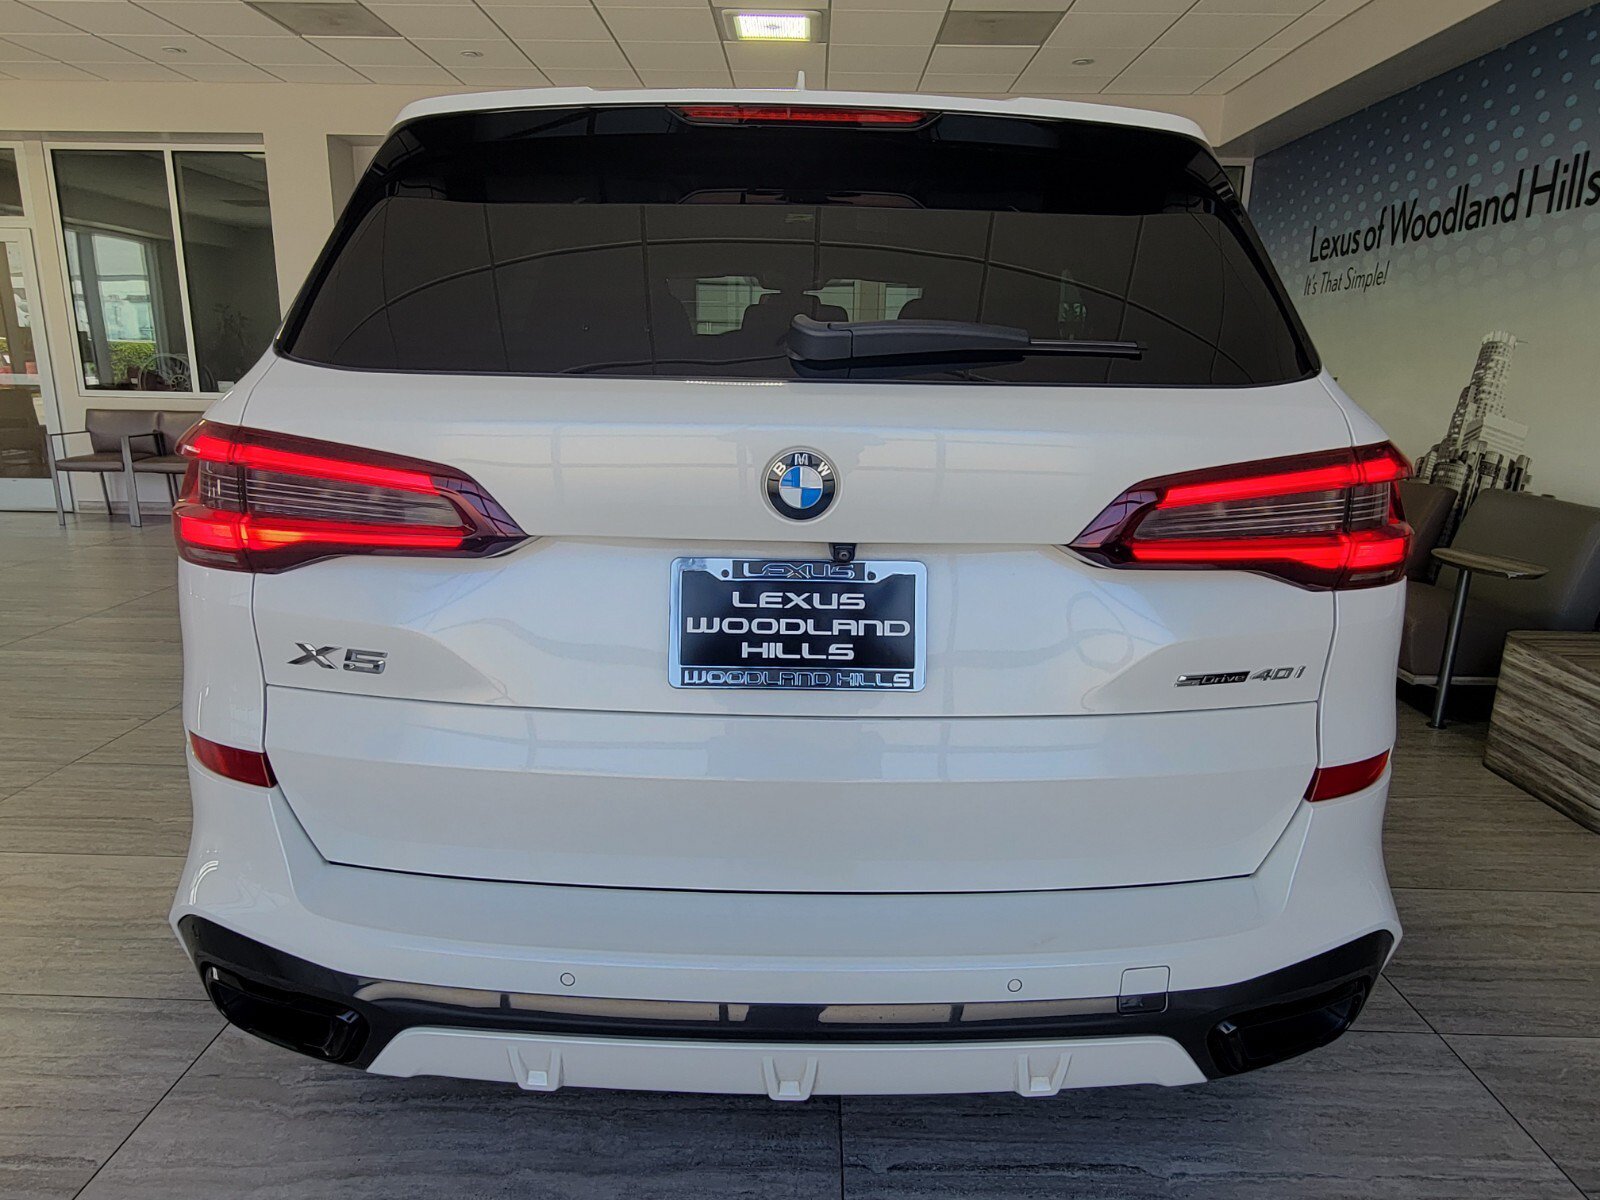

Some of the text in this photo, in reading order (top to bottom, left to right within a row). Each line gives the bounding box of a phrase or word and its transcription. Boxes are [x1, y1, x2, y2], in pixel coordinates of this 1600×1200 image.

[1310, 150, 1600, 263] Lexus of Woodland Hills
[1303, 260, 1390, 296] It's That Simple!
[772, 453, 831, 477] BMW
[742, 562, 856, 579] LEXUS
[732, 591, 866, 610] LEXUS
[686, 616, 911, 637] WOODLAND
[287, 642, 388, 674] X5
[741, 641, 855, 660] HILLS
[684, 670, 911, 688] WOODLAND HILLS
